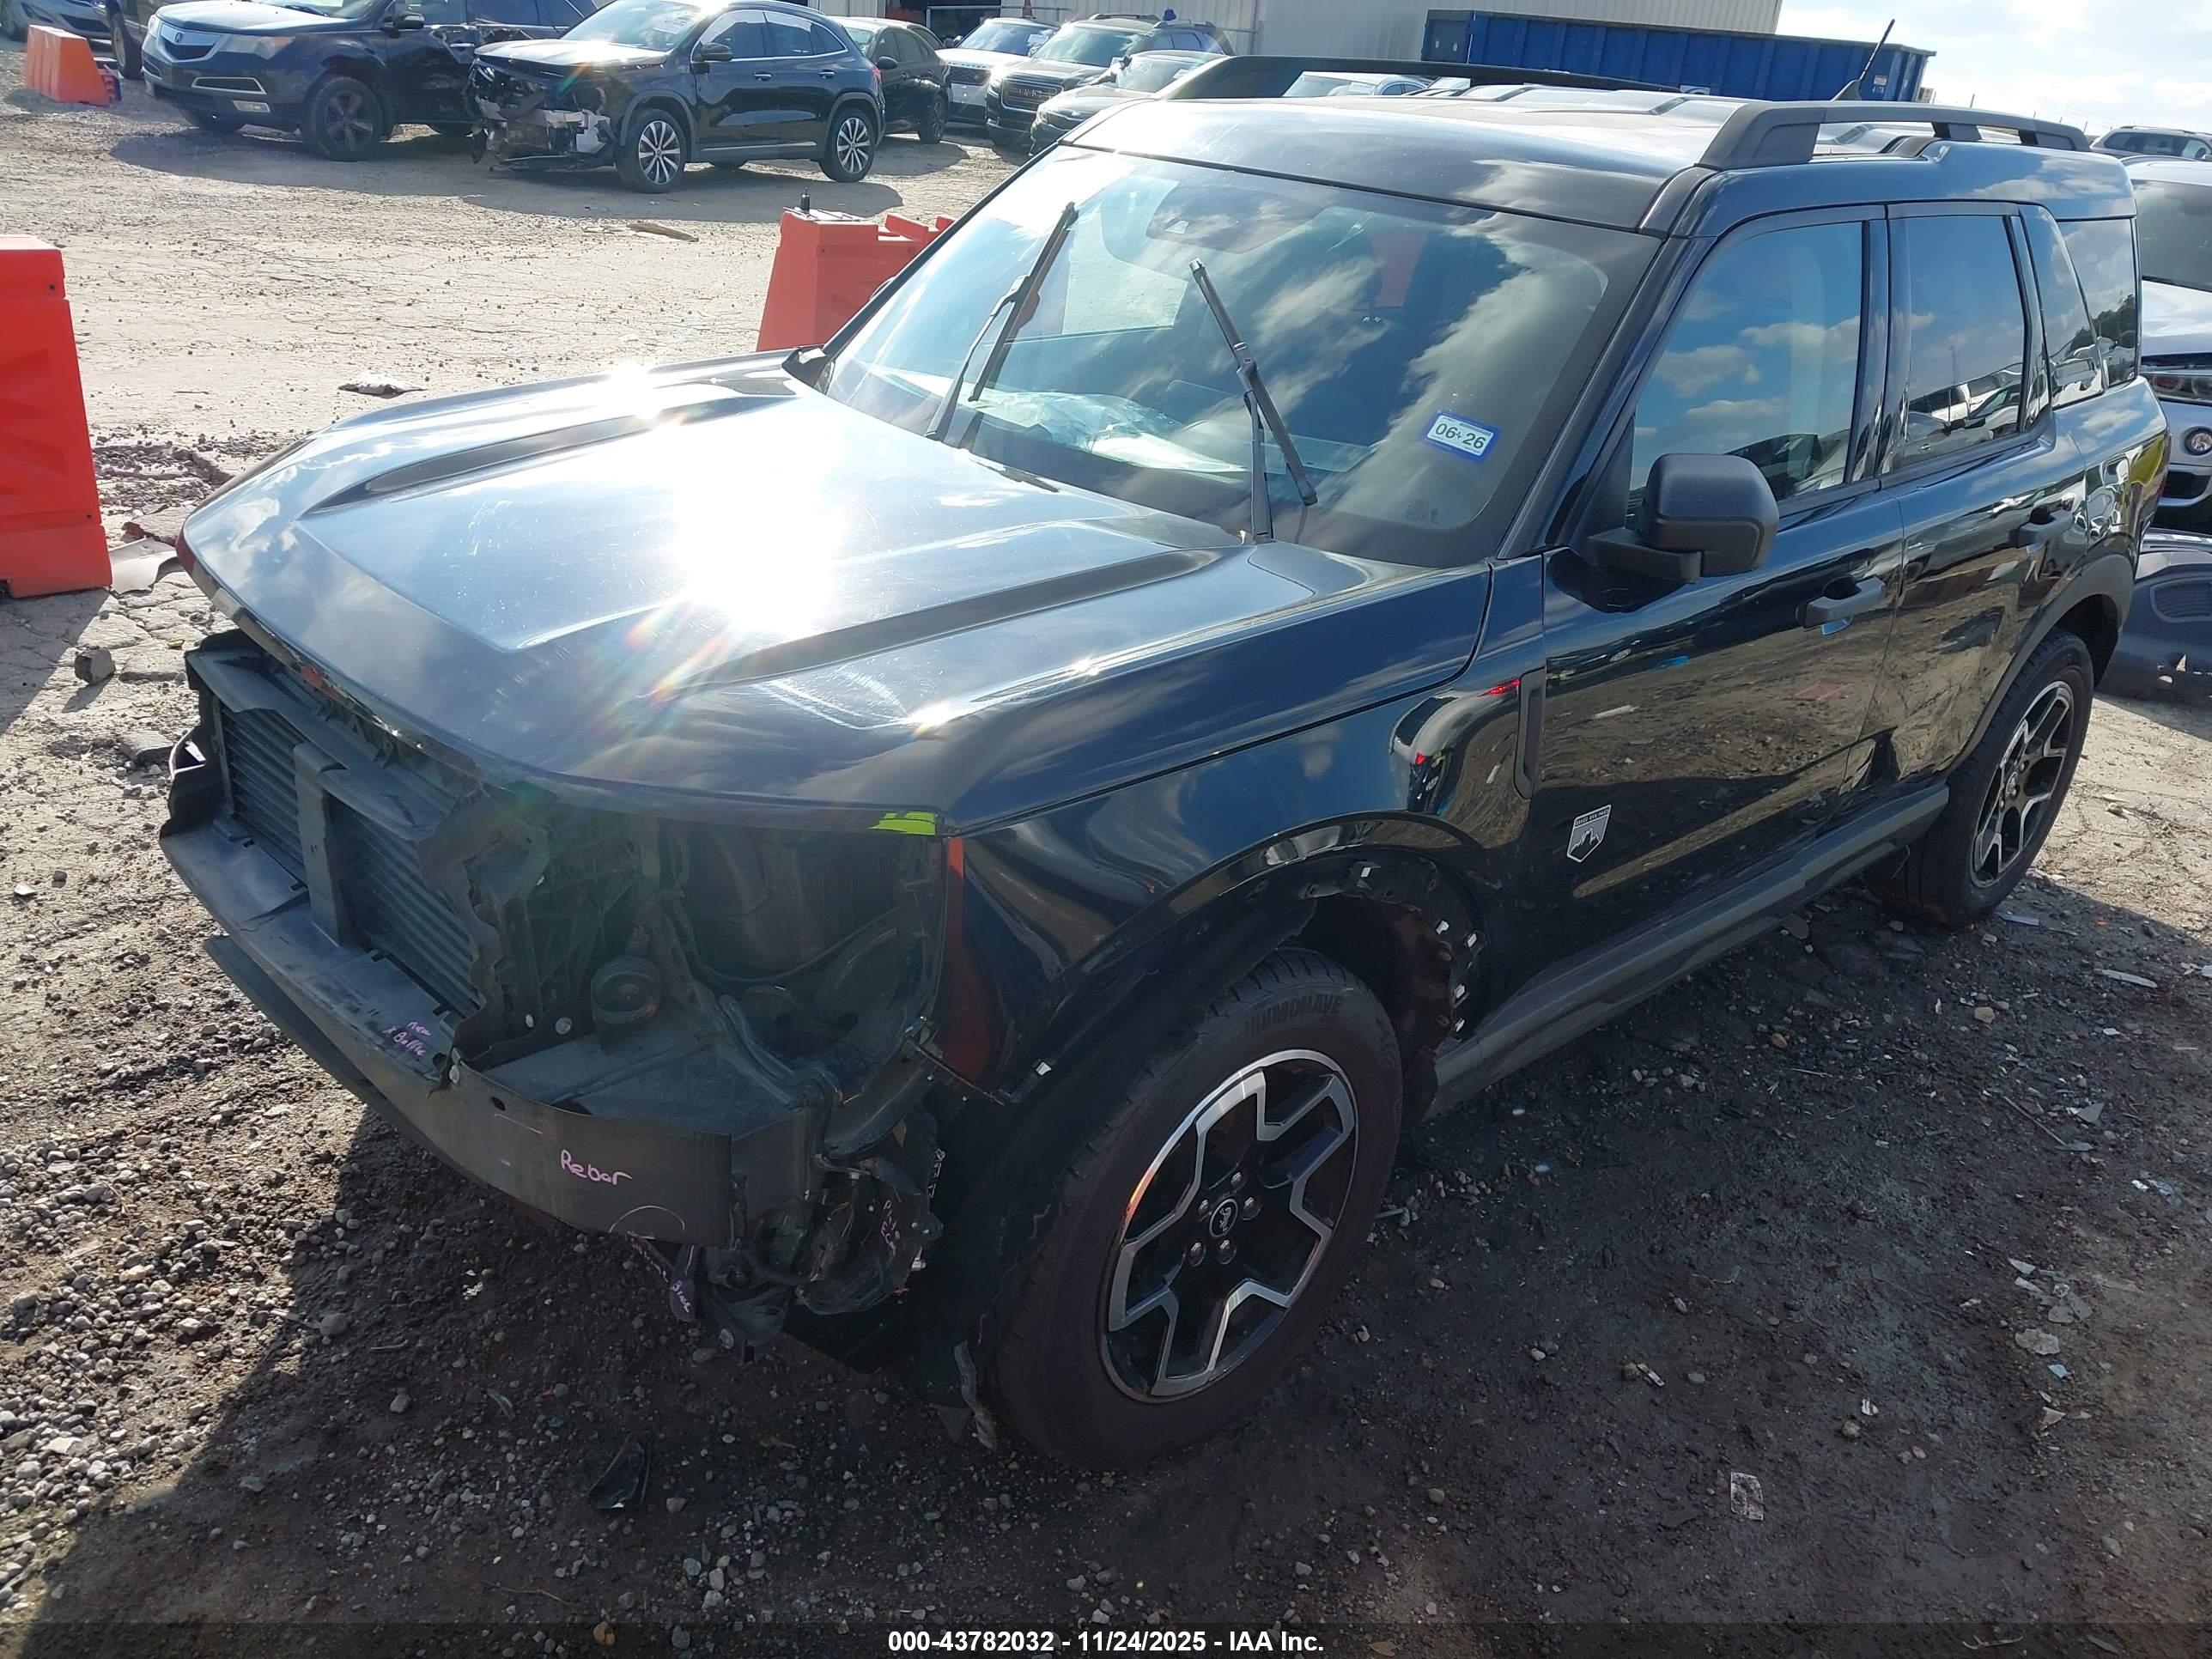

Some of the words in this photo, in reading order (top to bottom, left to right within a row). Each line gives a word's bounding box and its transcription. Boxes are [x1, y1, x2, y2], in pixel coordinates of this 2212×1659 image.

[1436, 422, 1458, 439] 06
[1462, 432, 1486, 449] 26
[561, 1149, 633, 1185] Rebar
